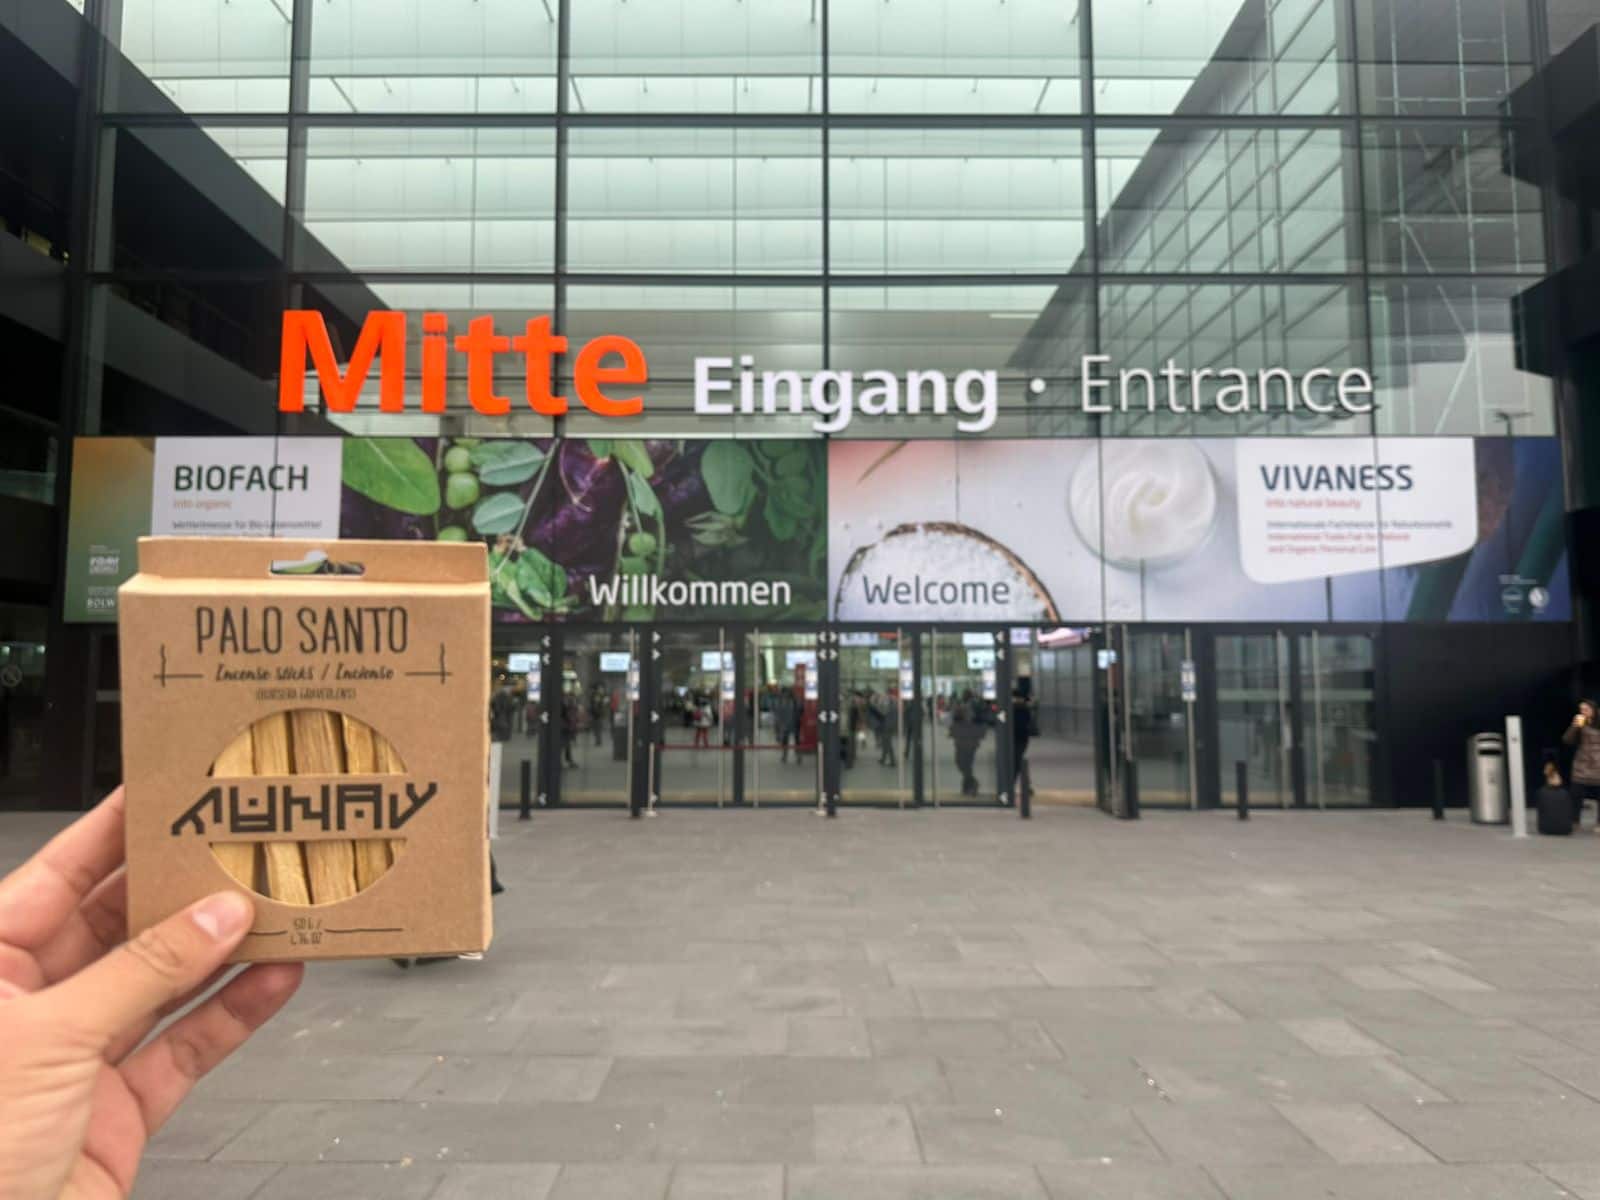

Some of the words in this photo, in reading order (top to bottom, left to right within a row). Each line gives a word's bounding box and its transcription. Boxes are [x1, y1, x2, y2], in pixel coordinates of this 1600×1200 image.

[278, 309, 648, 417] Mitte
[693, 355, 999, 432] Eingang
[1080, 354, 1374, 415] Entrance
[173, 464, 309, 492] BIOFACH
[1260, 464, 1414, 492] VIVANESS
[589, 574, 792, 607] Willkommen
[863, 575, 1011, 605] Welcome
[195, 605, 283, 655] PALO
[296, 605, 409, 654] SANTO
[215, 663, 270, 682] Incense
[276, 664, 314, 681] sticks
